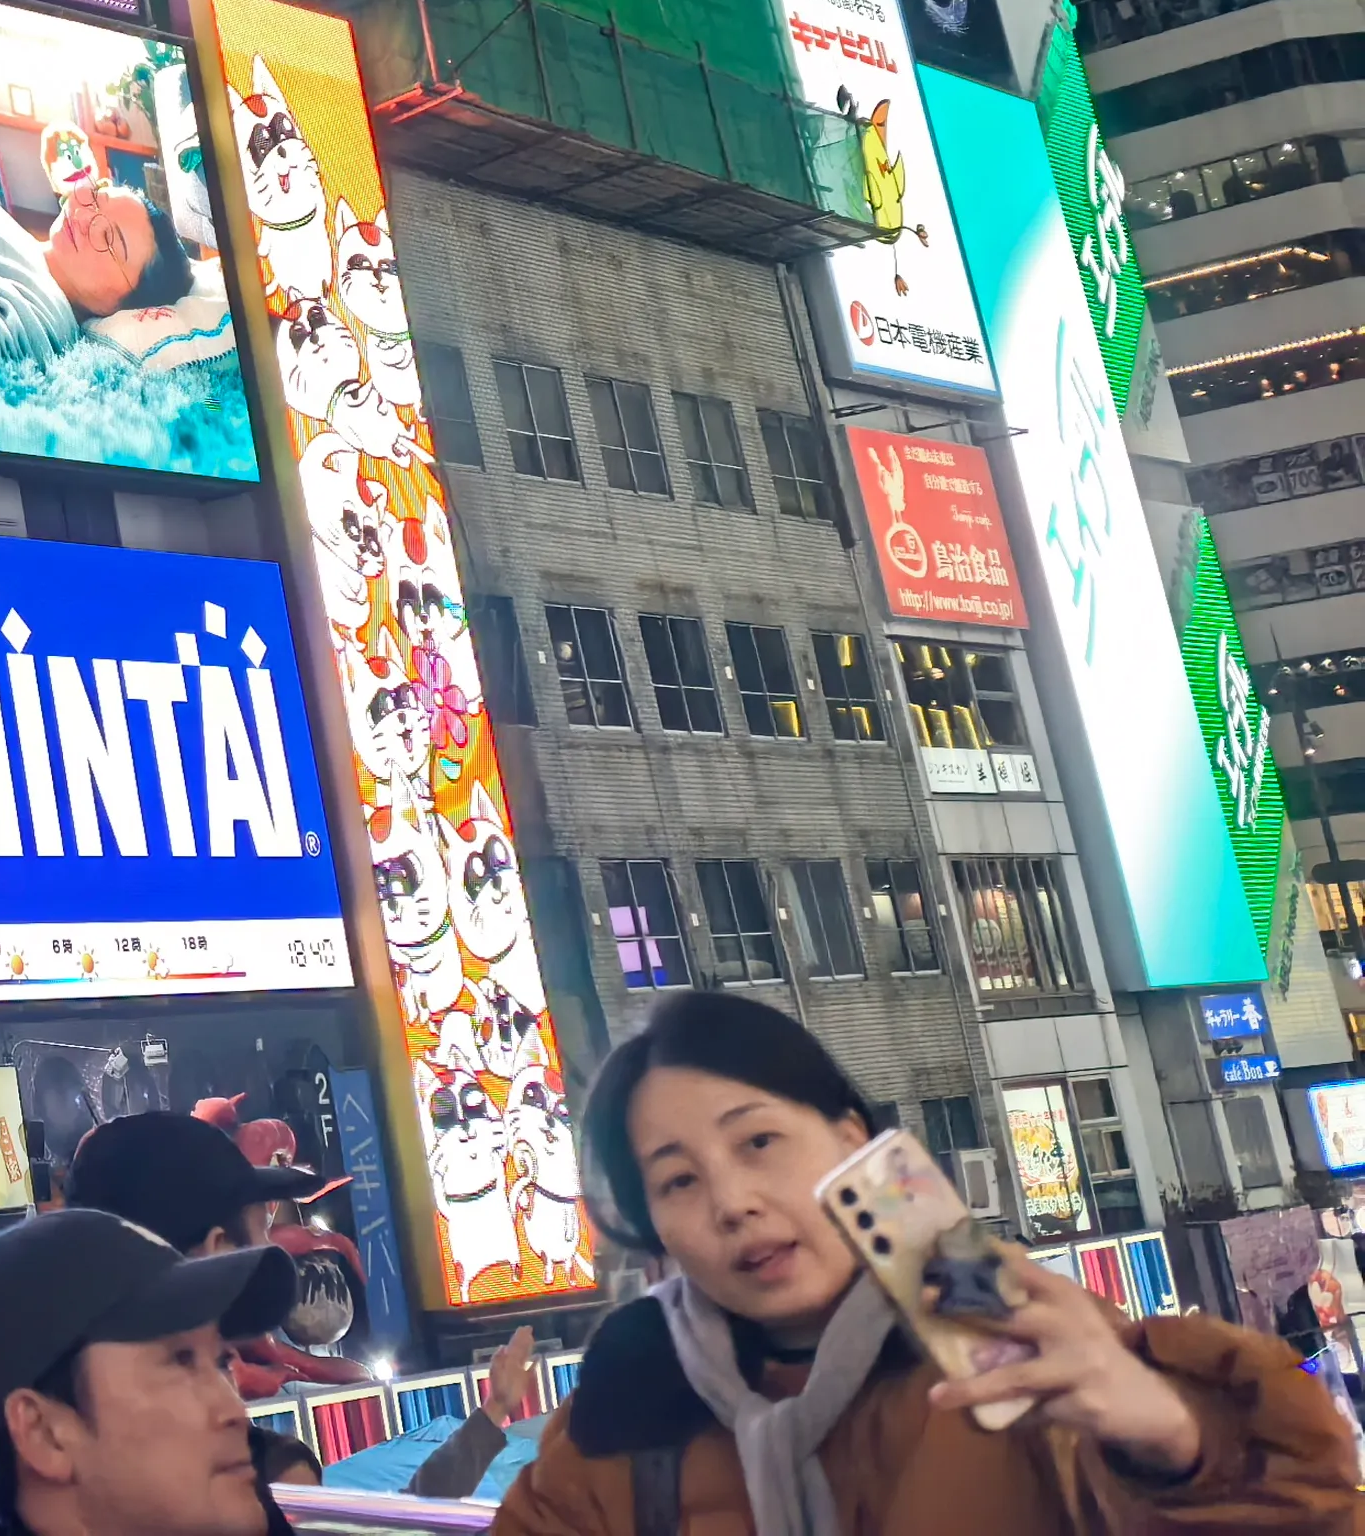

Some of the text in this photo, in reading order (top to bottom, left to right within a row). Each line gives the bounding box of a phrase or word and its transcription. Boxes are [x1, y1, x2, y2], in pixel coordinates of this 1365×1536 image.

[789, 10, 899, 74] キュービクル
